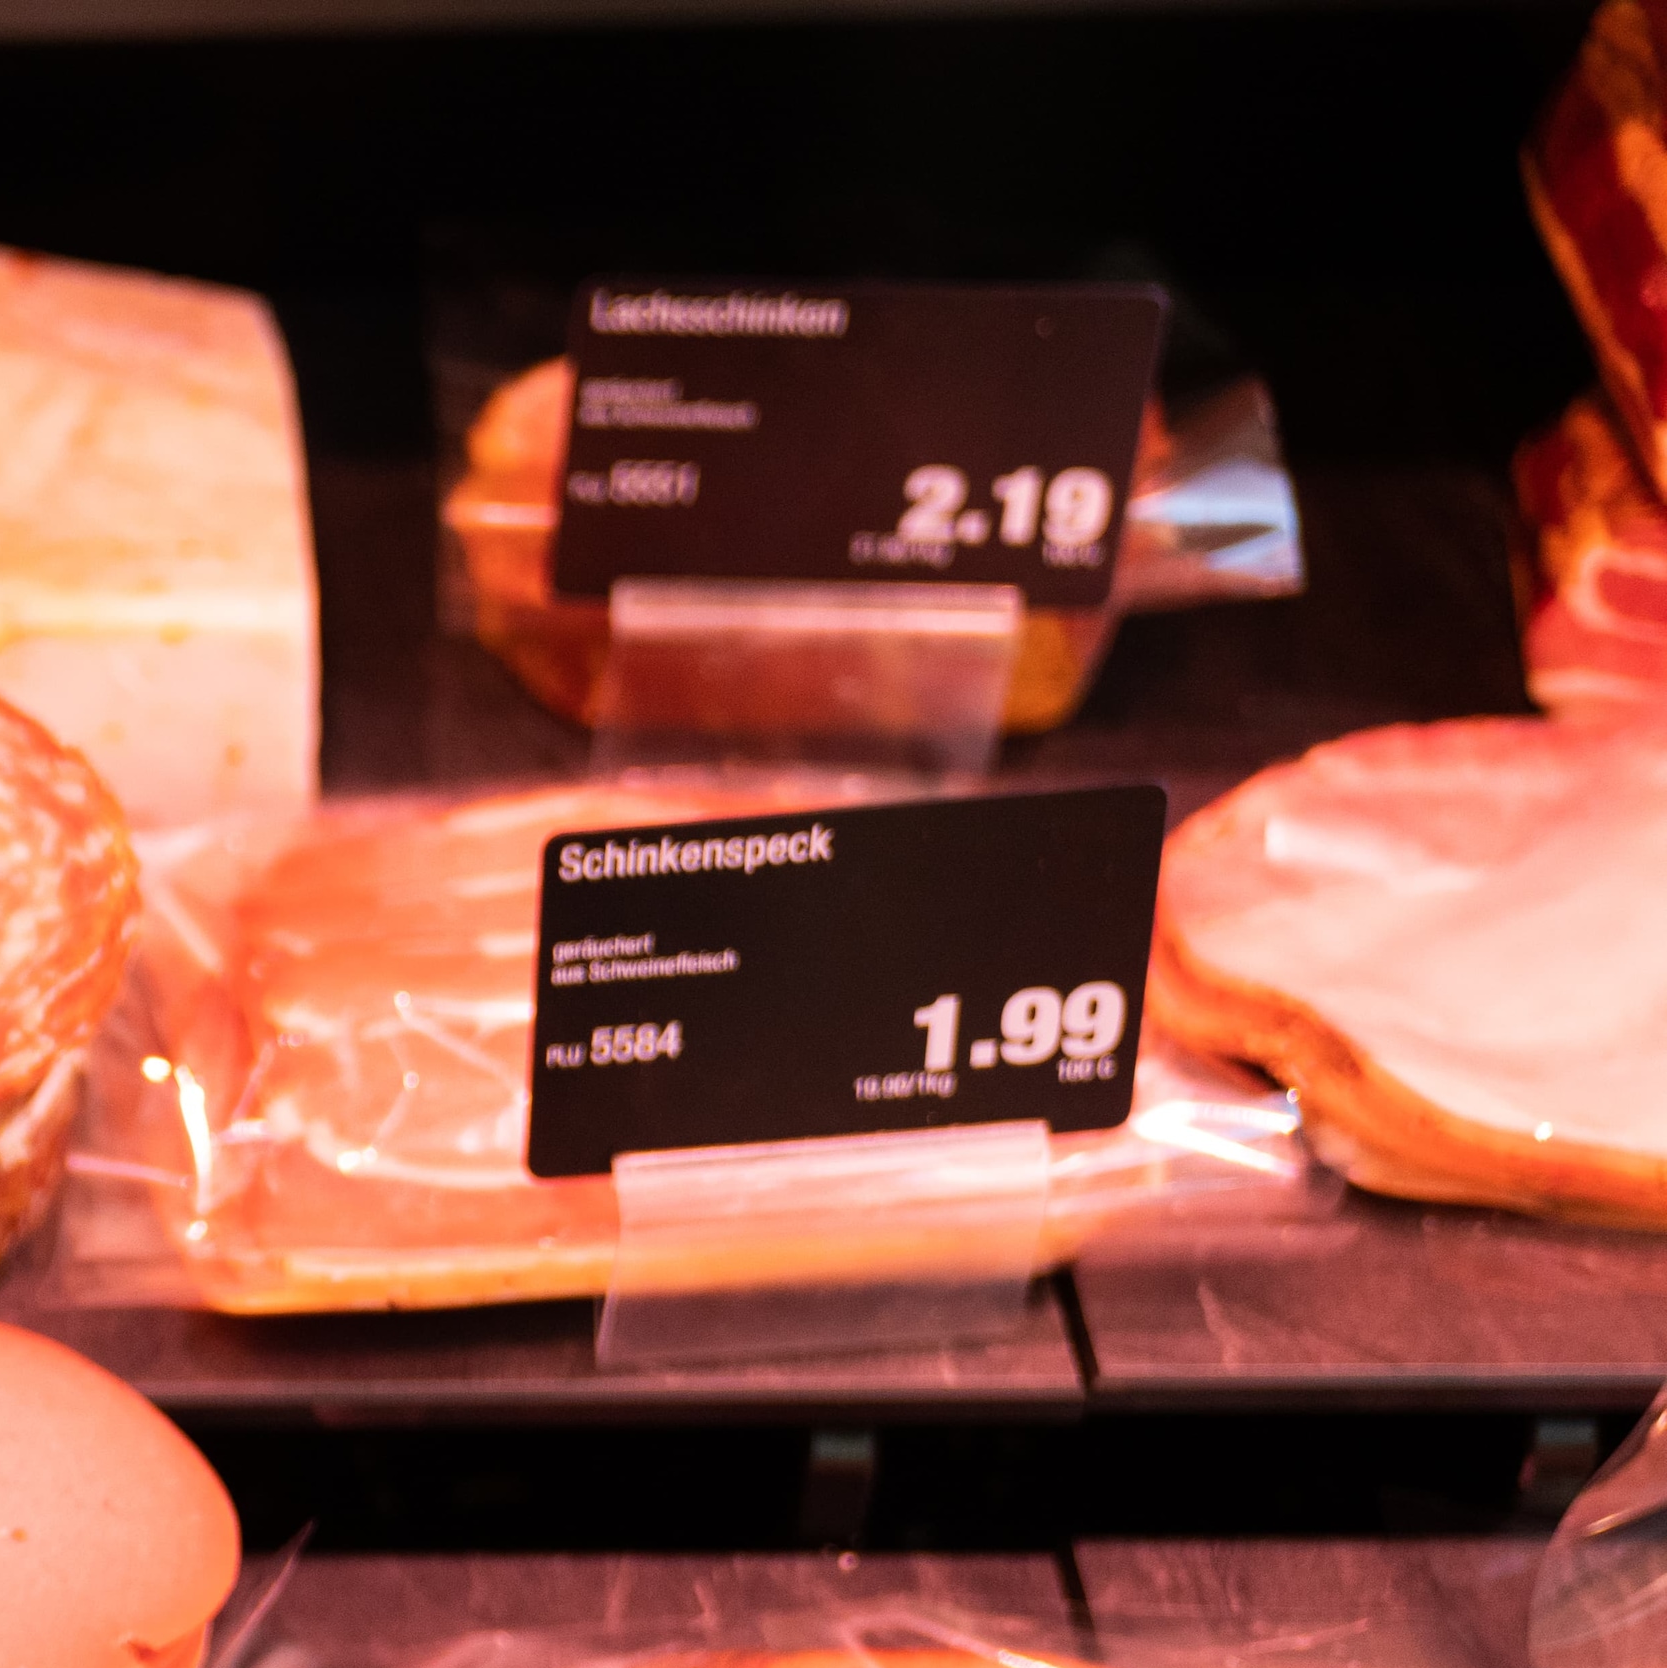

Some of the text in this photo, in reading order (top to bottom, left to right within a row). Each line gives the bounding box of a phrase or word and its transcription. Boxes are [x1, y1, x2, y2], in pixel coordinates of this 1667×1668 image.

[589, 288, 849, 338] Lachsschinken
[896, 463, 1113, 546] 2.19
[559, 822, 835, 882] Schinkenspeck
[550, 947, 740, 986] aus Schweinefleisch
[552, 931, 655, 966] geräuchert
[546, 1019, 683, 1067] PLU 5584
[913, 980, 1127, 1073] 1.99
